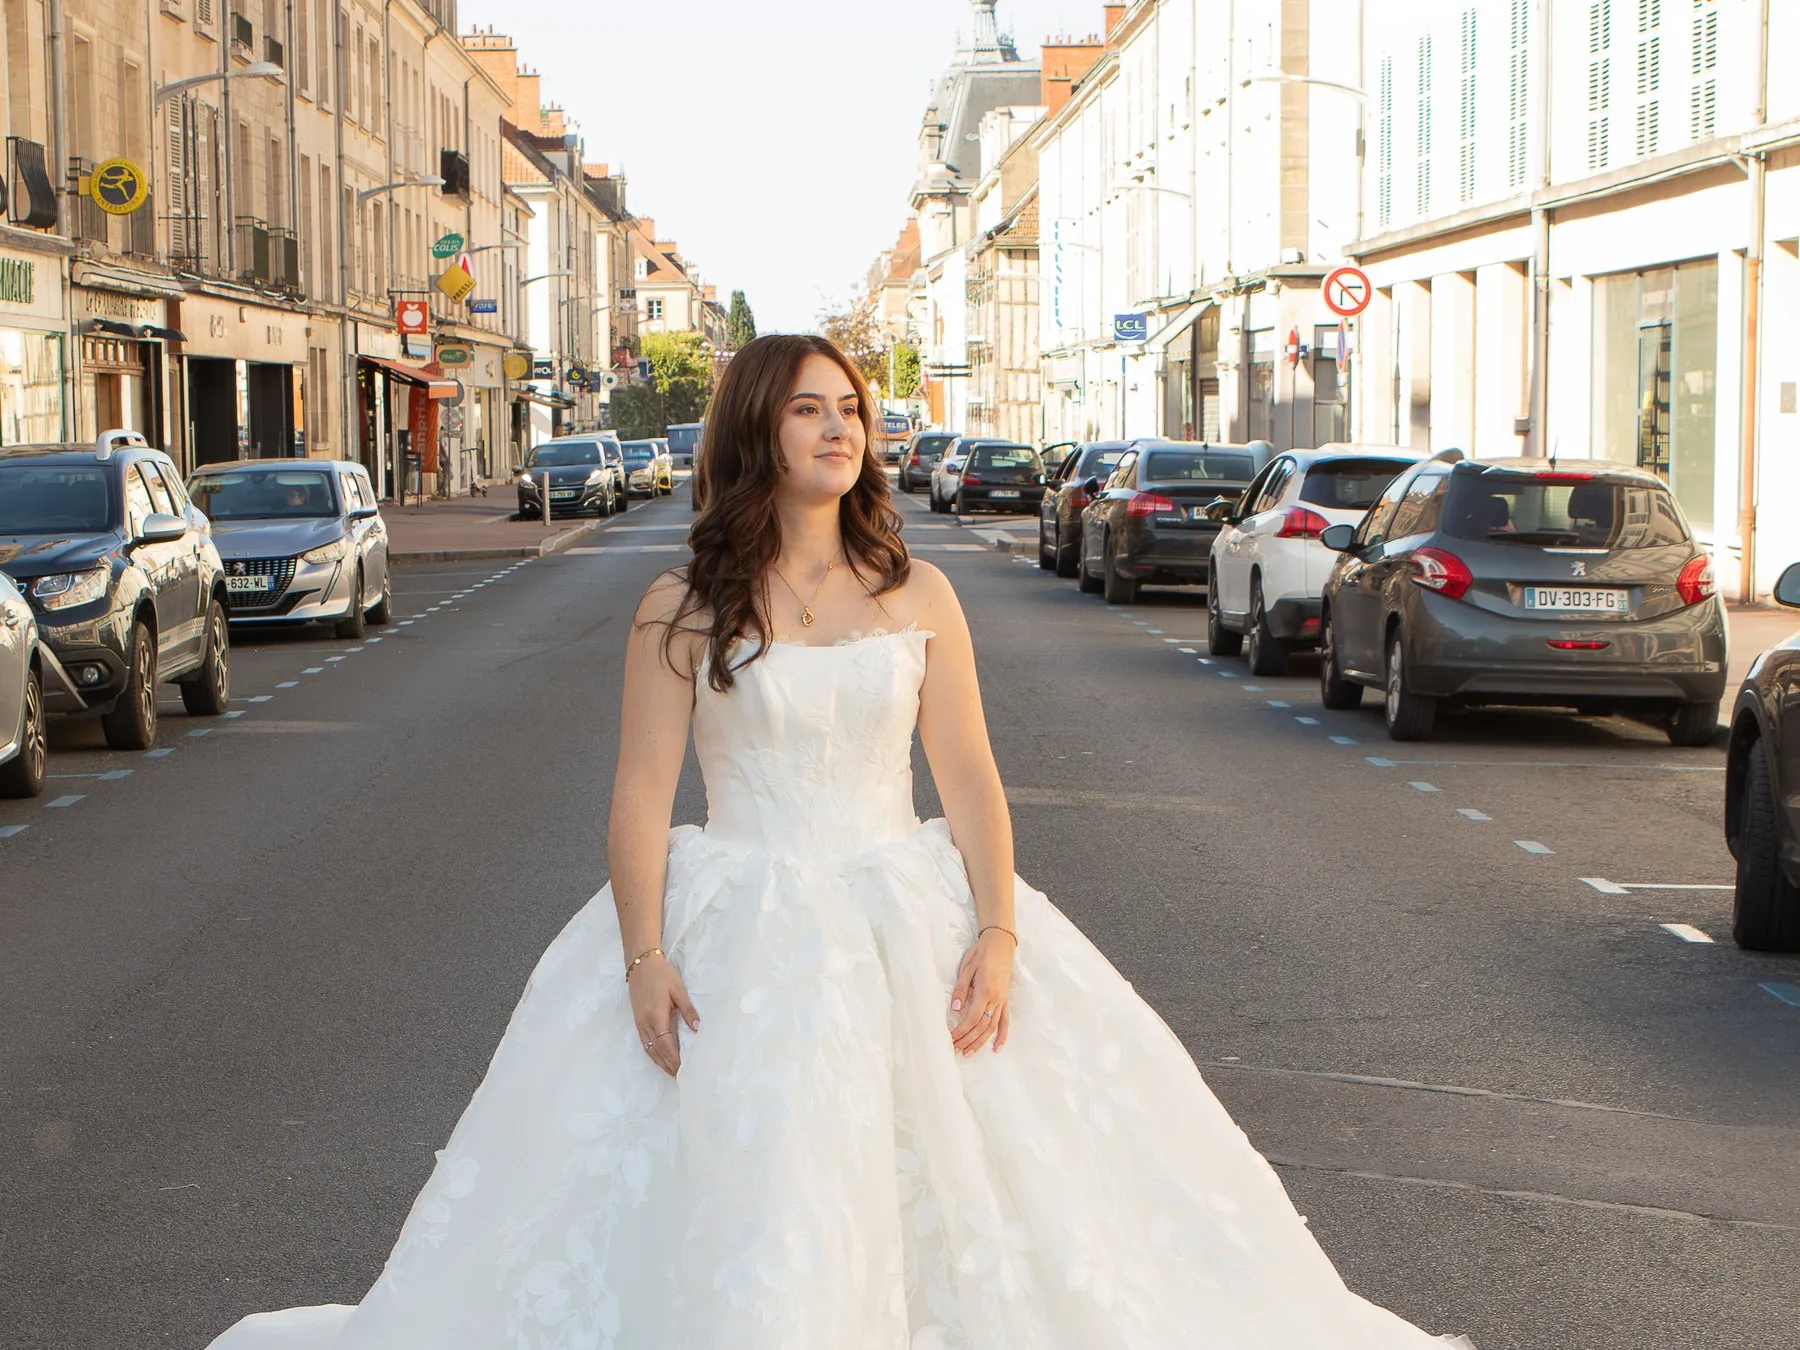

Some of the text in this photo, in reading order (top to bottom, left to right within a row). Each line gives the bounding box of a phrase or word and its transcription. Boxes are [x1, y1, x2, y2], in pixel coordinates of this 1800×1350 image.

[433, 244, 459, 252] COLIS
[452, 281, 473, 301] PRESSE
[620, 290, 636, 299] BAR
[1116, 320, 1144, 330] LCL
[1539, 591, 1614, 608] DV-303-FG
